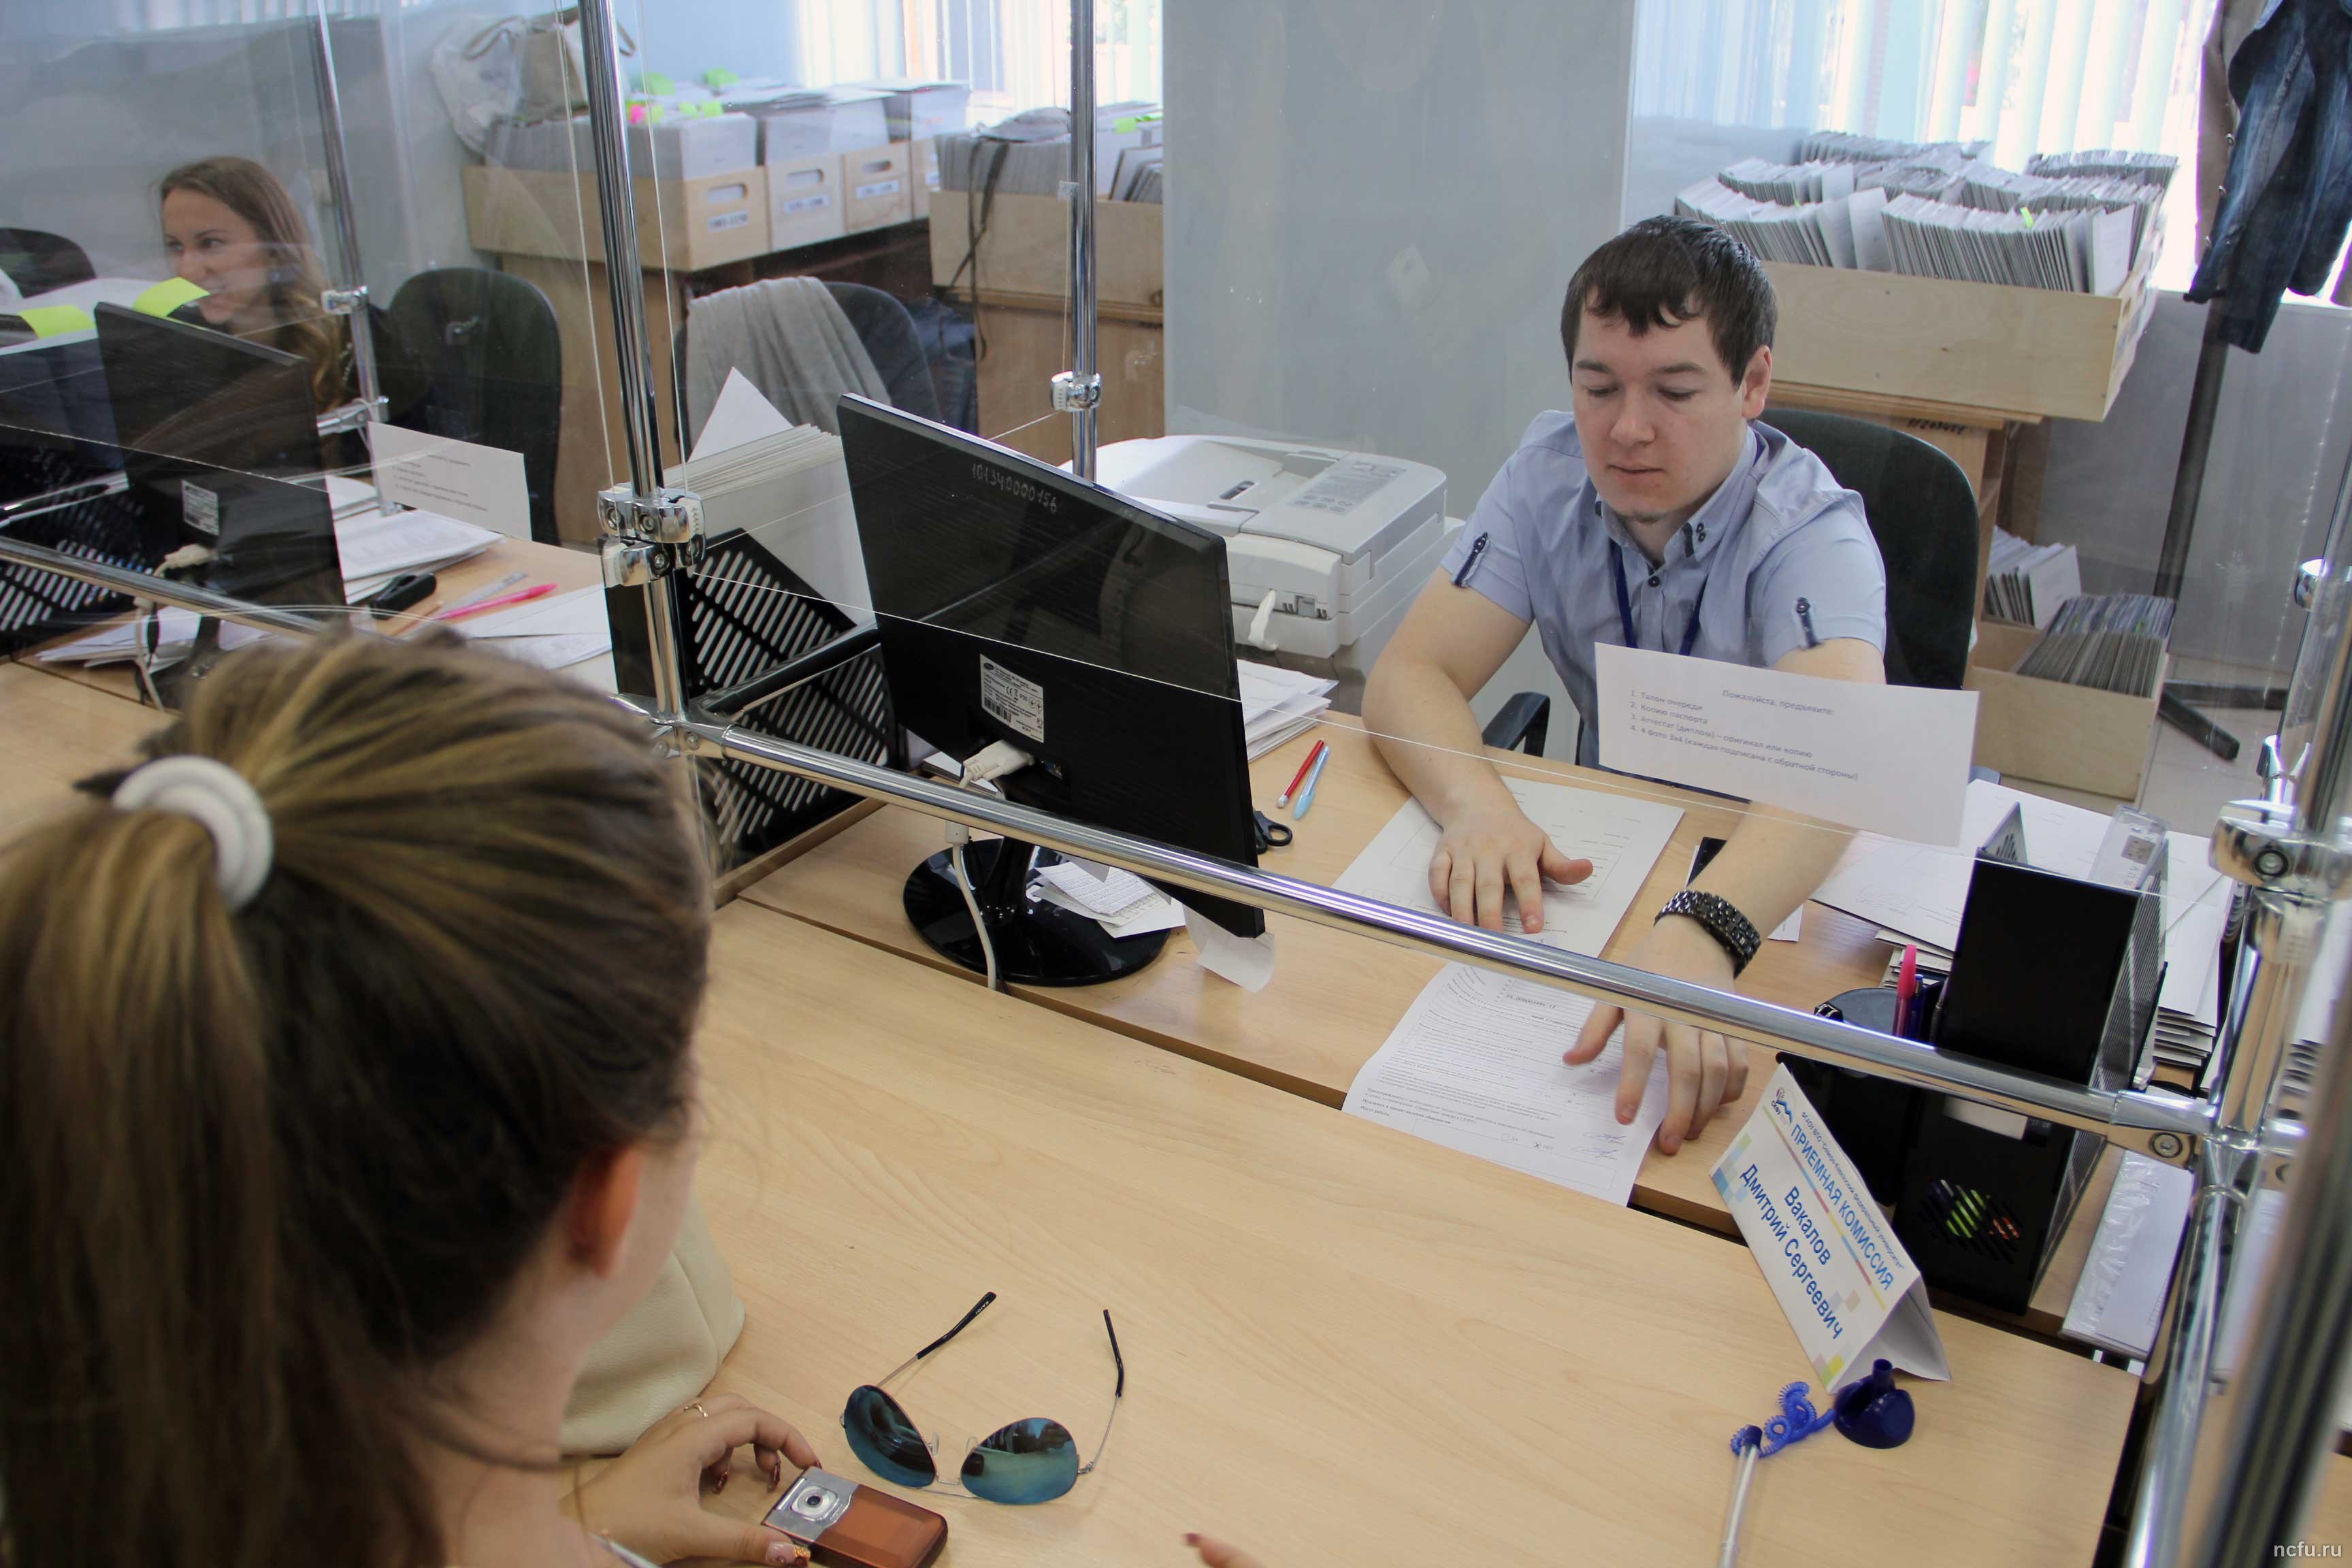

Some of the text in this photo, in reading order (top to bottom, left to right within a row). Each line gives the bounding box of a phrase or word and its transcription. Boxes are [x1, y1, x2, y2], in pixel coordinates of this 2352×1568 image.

[1641, 691, 1665, 703] Талон
[1667, 698, 1703, 710] очереди
[1641, 704, 1667, 716] Копию
[1669, 711, 1708, 725] паспорта
[1722, 689, 1835, 715] Пожалуйста, предъявите:
[1641, 715, 1674, 729] Аттестат
[1676, 723, 1714, 739] (диплом)
[1723, 735, 1763, 748] оригинал
[1784, 748, 1813, 758] копию
[1648, 728, 1667, 740] фото
[1684, 737, 1719, 752] (каждая
[1720, 746, 1765, 762] подписана
[1774, 757, 1815, 771] обратной
[1817, 767, 1859, 781] стороны)
[1784, 1186, 1831, 1266] Вакалов
[1791, 1124, 1895, 1292] ПРИЕМНАЯ КОМИССИЯ
[1740, 1163, 1844, 1340] Дмитрий Сергеевич
